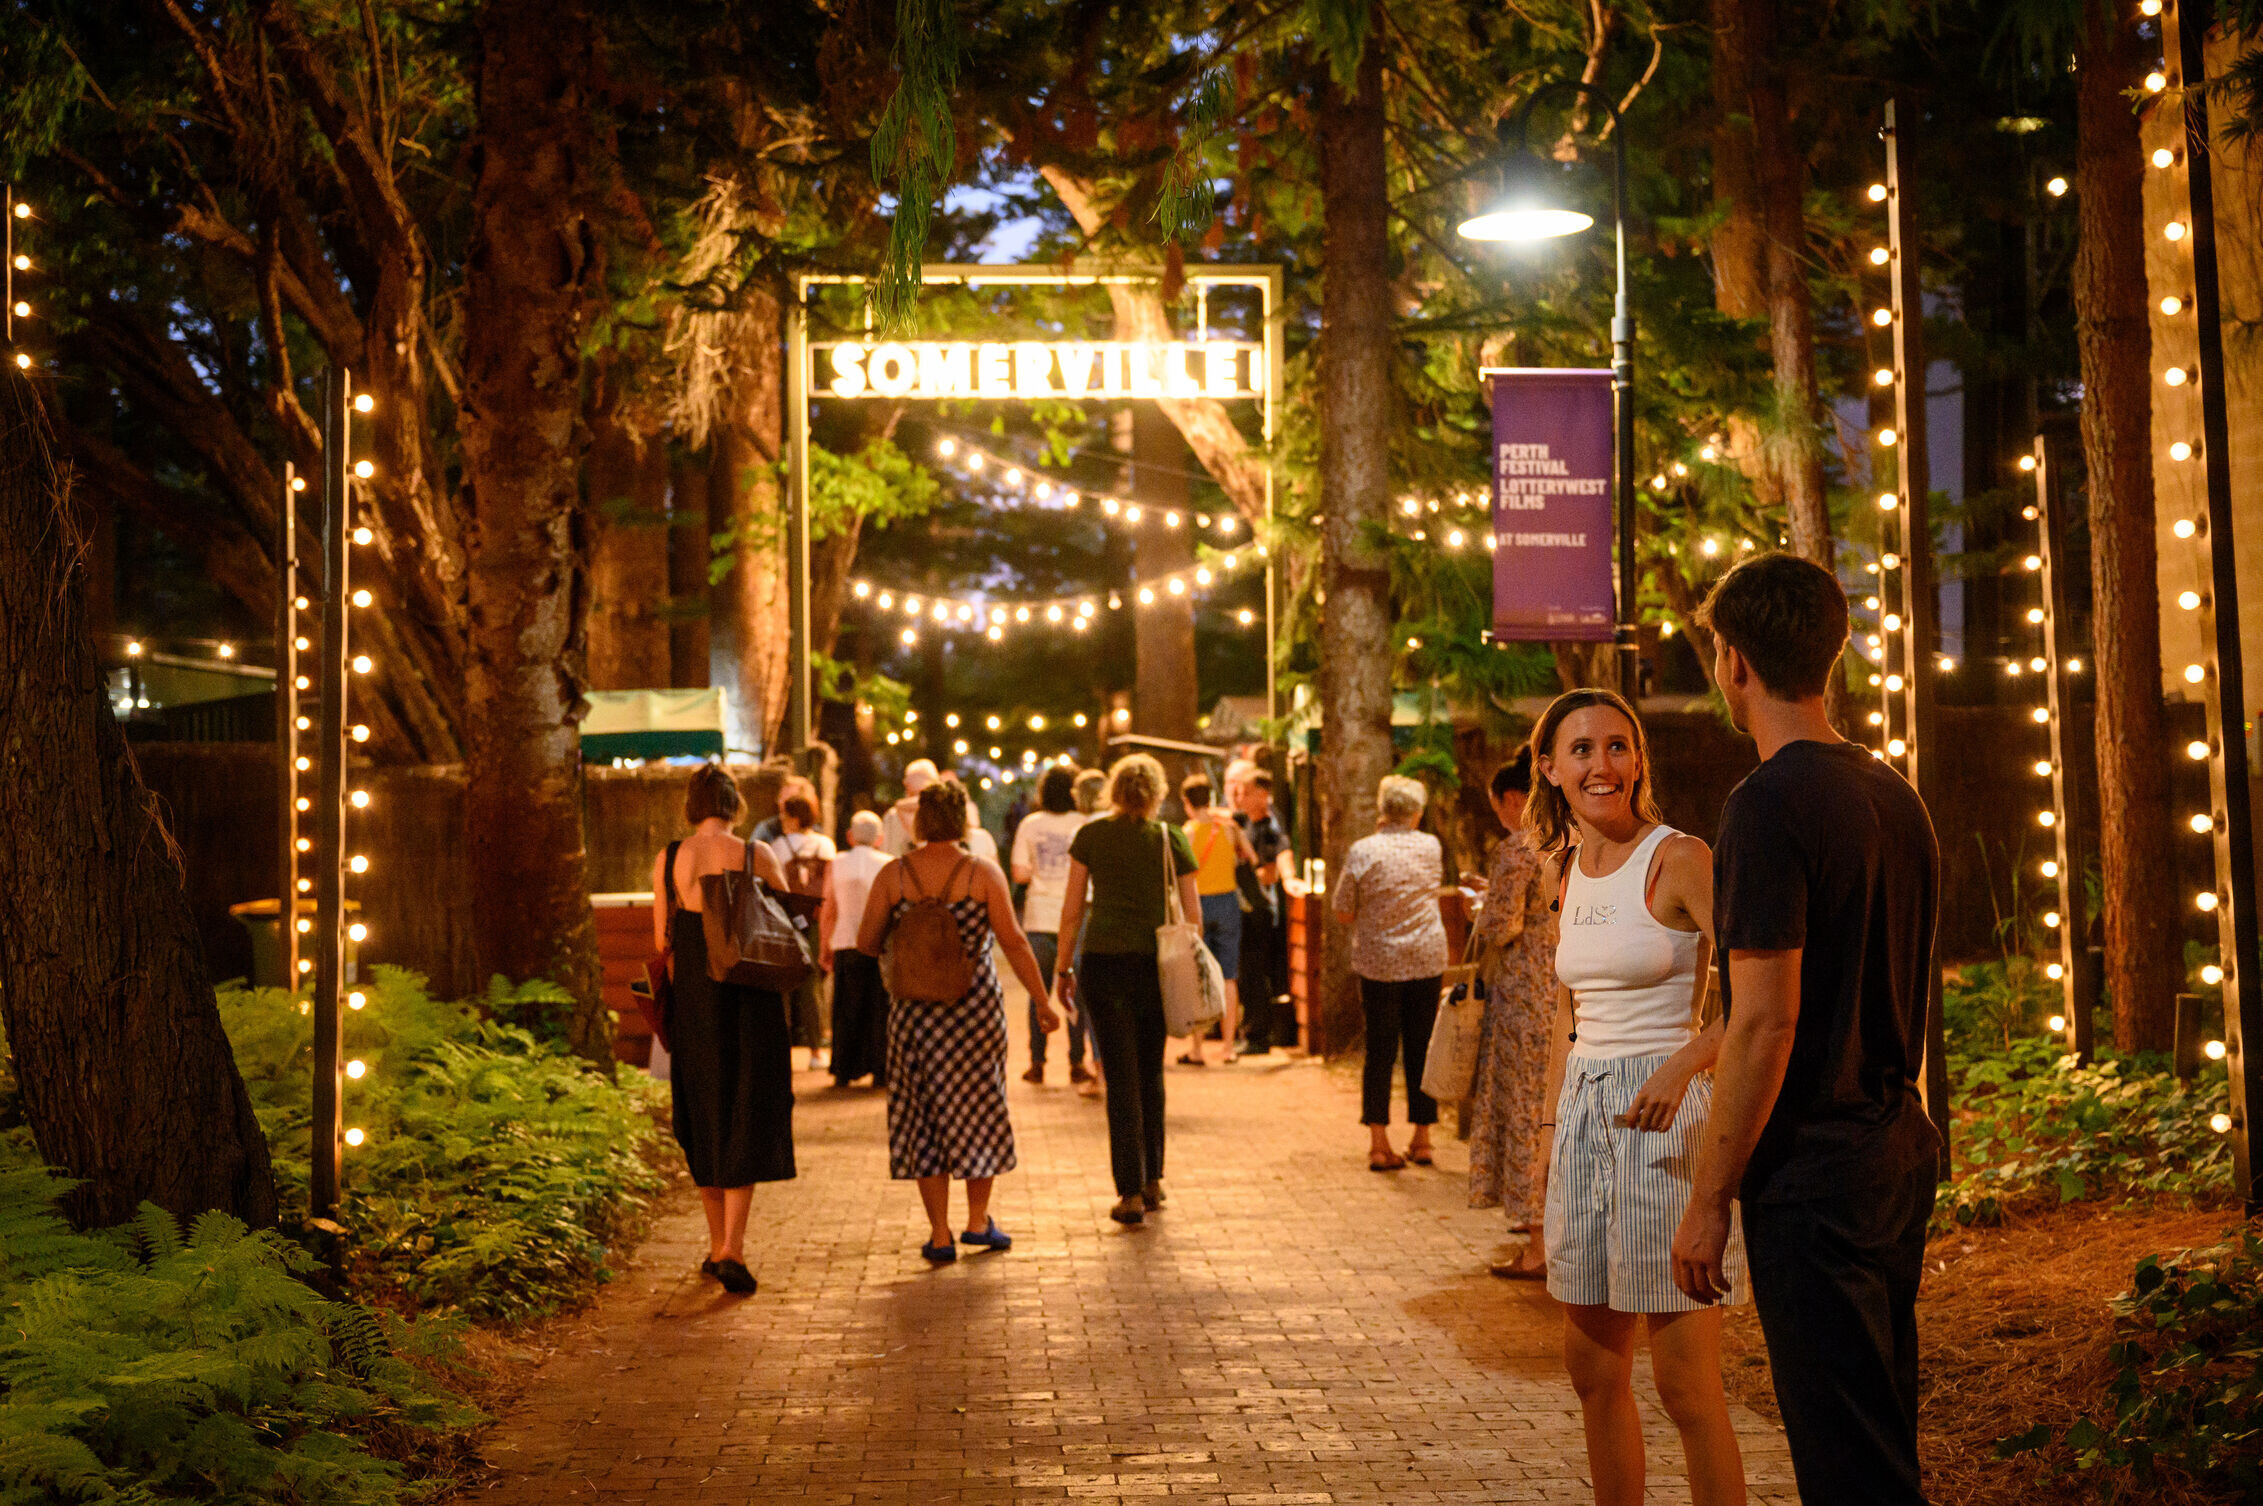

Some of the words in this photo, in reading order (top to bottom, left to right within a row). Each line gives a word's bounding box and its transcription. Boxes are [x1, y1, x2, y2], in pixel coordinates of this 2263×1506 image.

[830, 341, 1238, 398] SOMERVILLE
[1500, 443, 1549, 459] PERTH
[1500, 460, 1569, 475] FESTIVAL
[1500, 478, 1607, 495] LOTTERYWEST
[1500, 495, 1546, 510] FILMS
[1500, 533, 1513, 546] AT
[1515, 533, 1587, 547] SOMERVILLE
